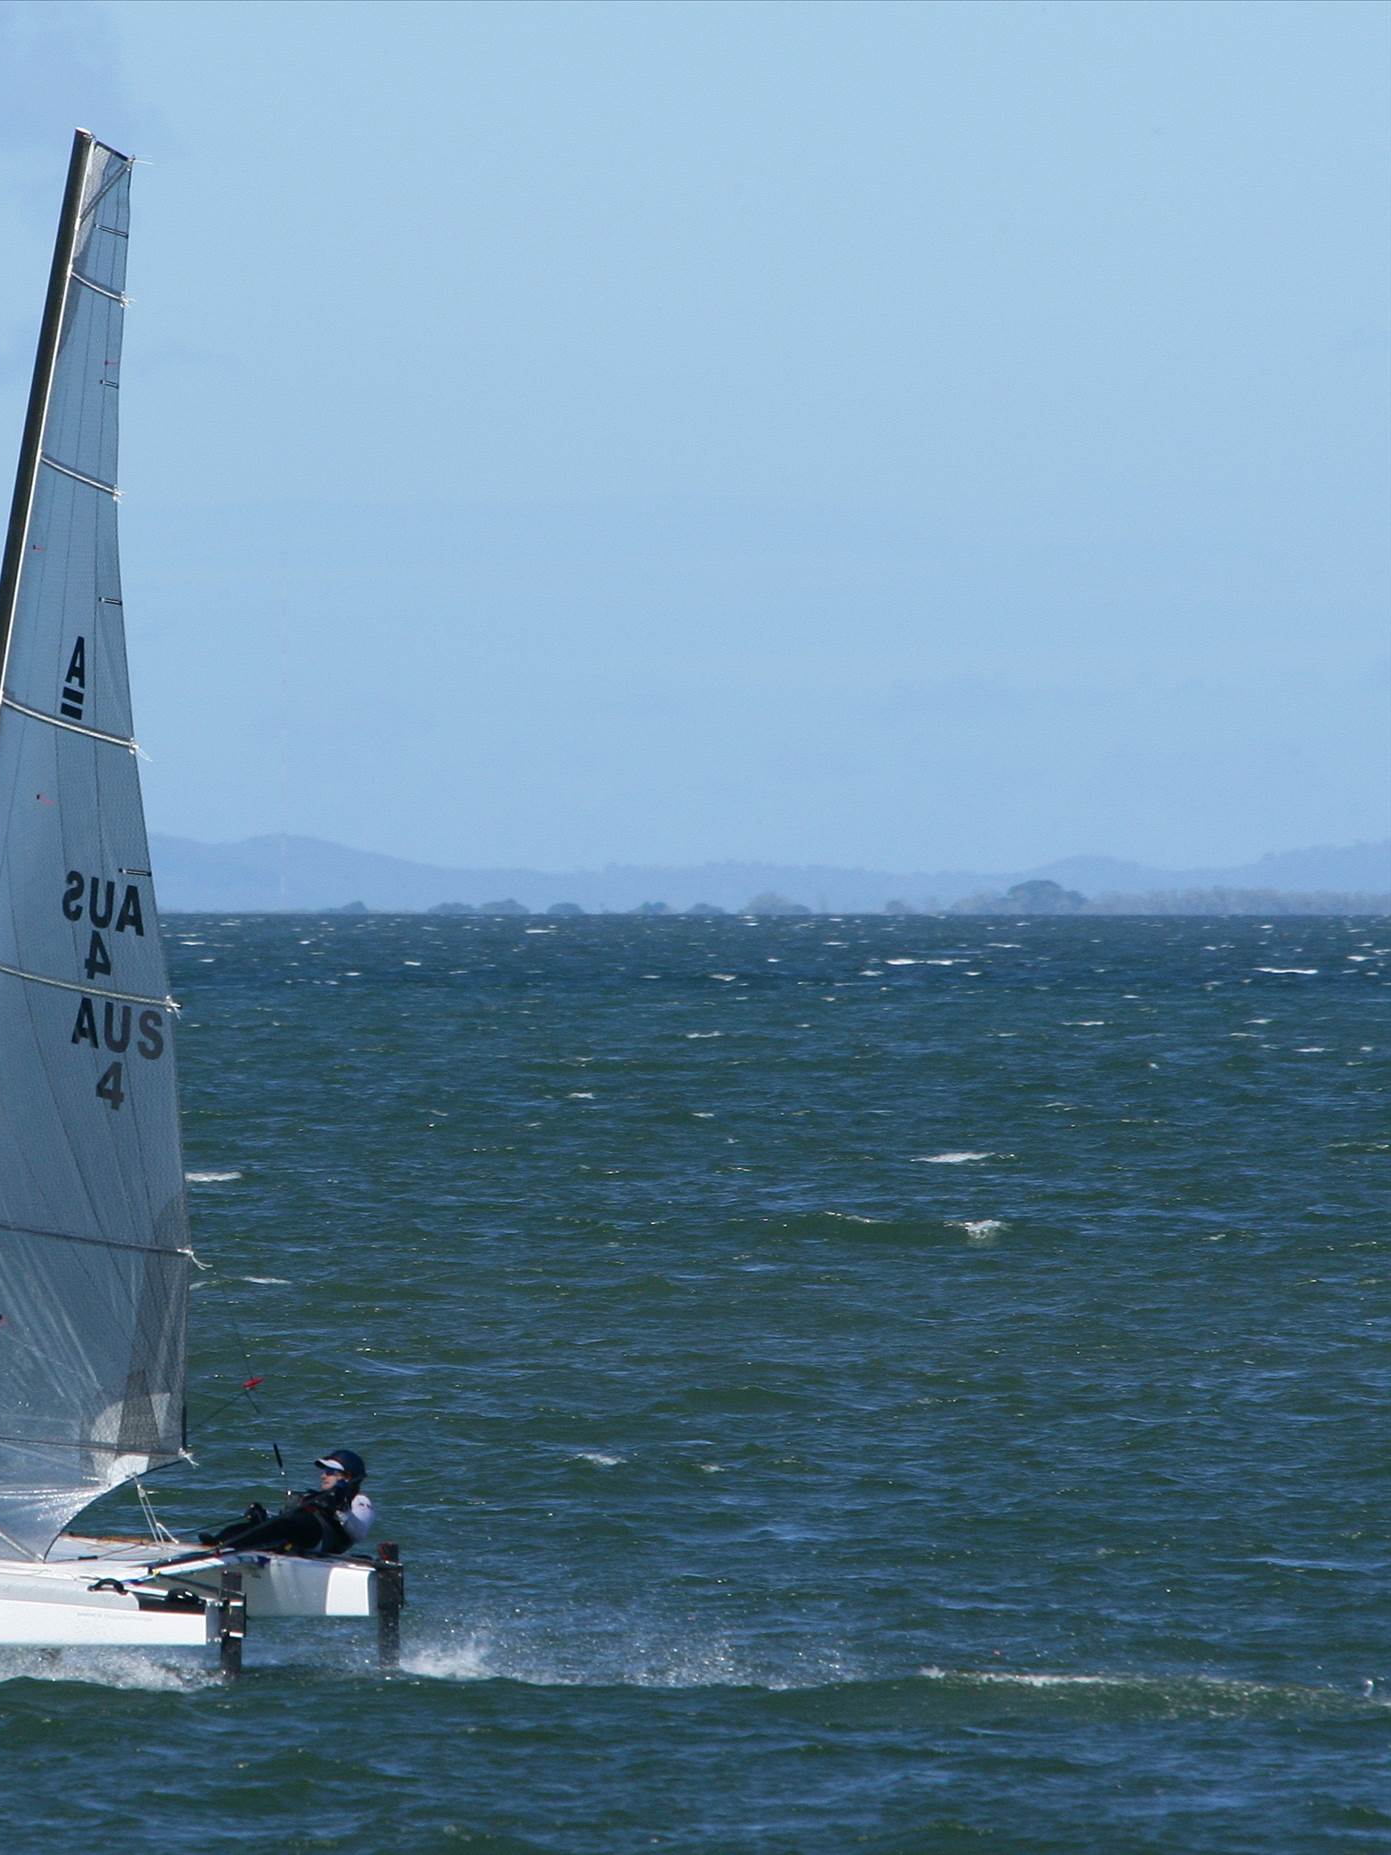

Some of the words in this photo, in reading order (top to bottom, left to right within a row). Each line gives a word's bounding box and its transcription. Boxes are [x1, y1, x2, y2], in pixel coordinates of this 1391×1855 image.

[65, 636, 86, 689] A
[71, 996, 165, 1061] AUS
[95, 1061, 125, 1111] 4
